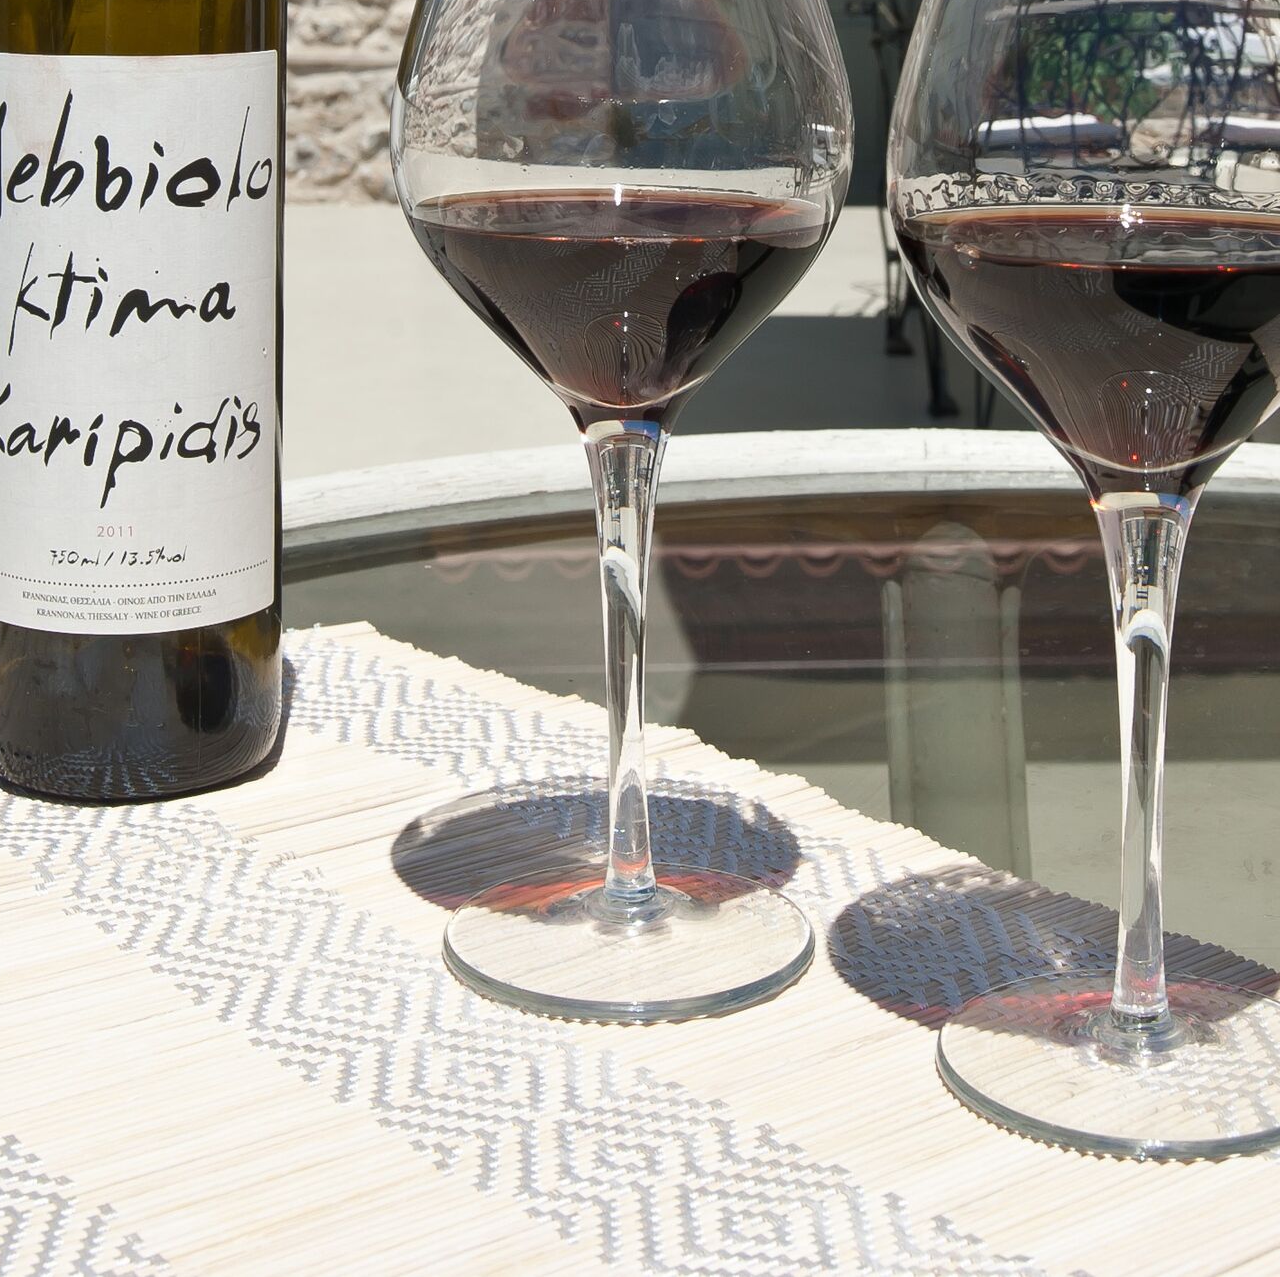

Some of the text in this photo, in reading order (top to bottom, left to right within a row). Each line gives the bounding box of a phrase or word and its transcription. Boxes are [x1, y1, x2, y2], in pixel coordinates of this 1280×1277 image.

[96, 525, 134, 538] 2011
[70, 596, 112, 606] ΘΕΣΣΑΛΙΑ
[117, 597, 146, 606] ΟΙΝΟΣ
[146, 595, 166, 605] ΑΠΟ
[167, 593, 185, 603] ΤΗΝ
[186, 588, 217, 601] ΕΛΛΑΔΑ
[87, 612, 129, 621] THESSALY
[134, 610, 159, 620] WINE
[160, 609, 170, 618] OF
[172, 605, 202, 617] GREECE
